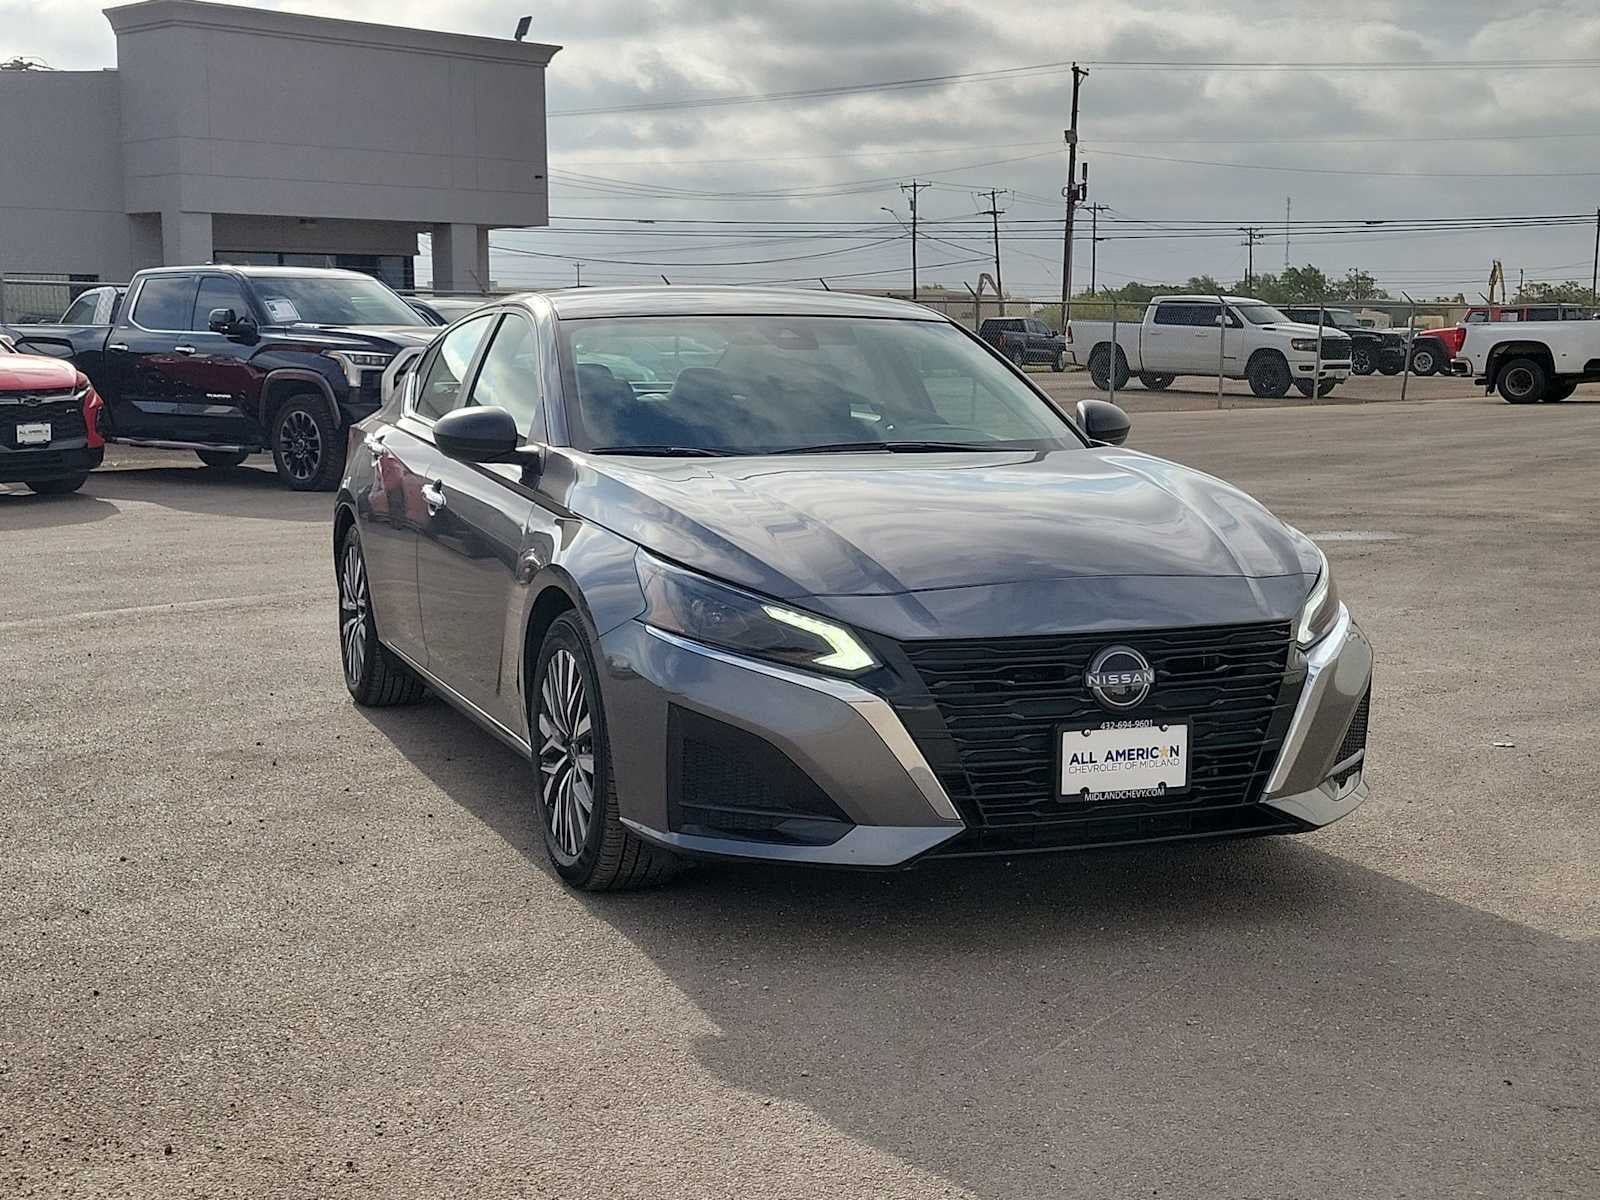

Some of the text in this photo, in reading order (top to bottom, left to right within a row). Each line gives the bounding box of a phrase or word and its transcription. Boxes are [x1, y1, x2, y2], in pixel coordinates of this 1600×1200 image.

[1088, 671, 1153, 685] NISSAN
[1068, 757, 1180, 774] CHEVROLET OF MIDLAND
[1070, 752, 1098, 765] ALL
[1084, 787, 1165, 801] MIDLANDCHEVY.COM
